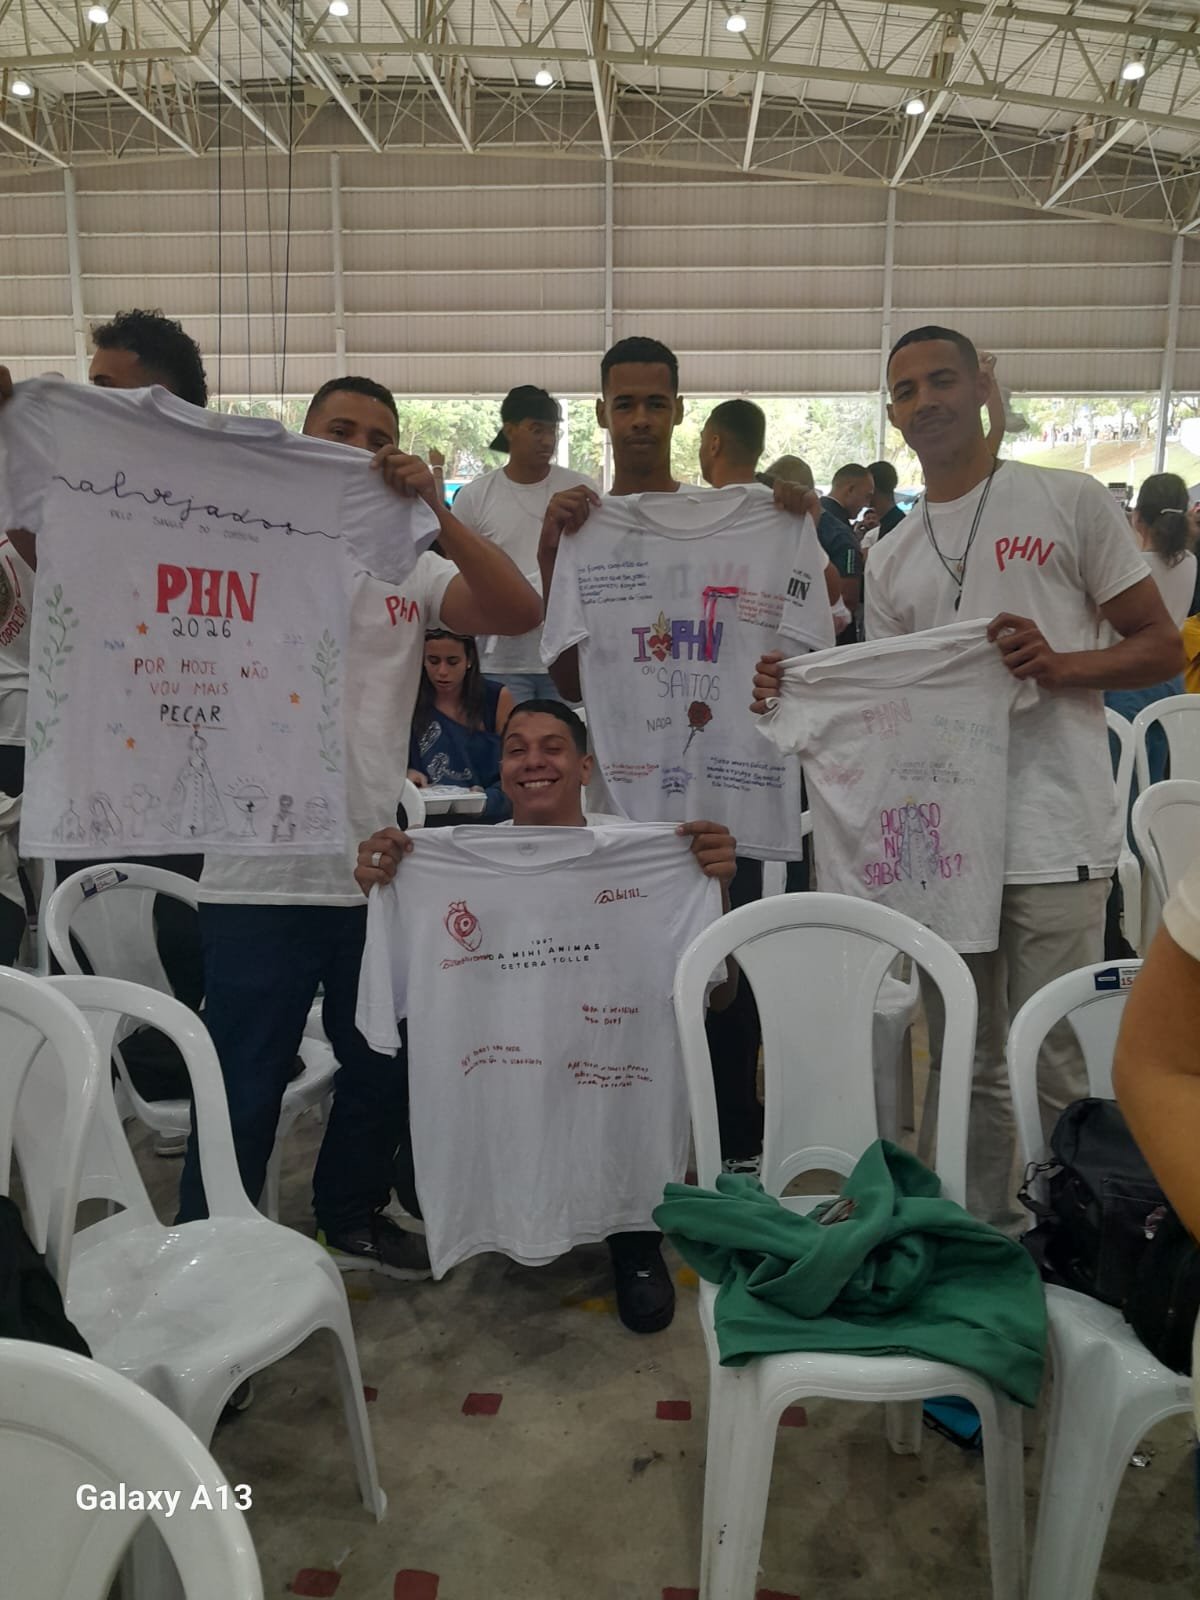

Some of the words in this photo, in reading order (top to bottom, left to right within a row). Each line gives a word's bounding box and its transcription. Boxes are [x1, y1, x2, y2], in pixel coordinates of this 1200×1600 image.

[995, 535, 1055, 572] PHN
[156, 563, 260, 623] PHN
[171, 616, 232, 639] 2026
[133, 656, 166, 675] POR
[181, 658, 218, 676] HOJE
[240, 661, 269, 680] NÃO
[150, 681, 181, 696] VOU
[193, 682, 230, 696] MAIS
[159, 703, 222, 724] PECAR
[548, 943, 600, 954] ANIMAS
